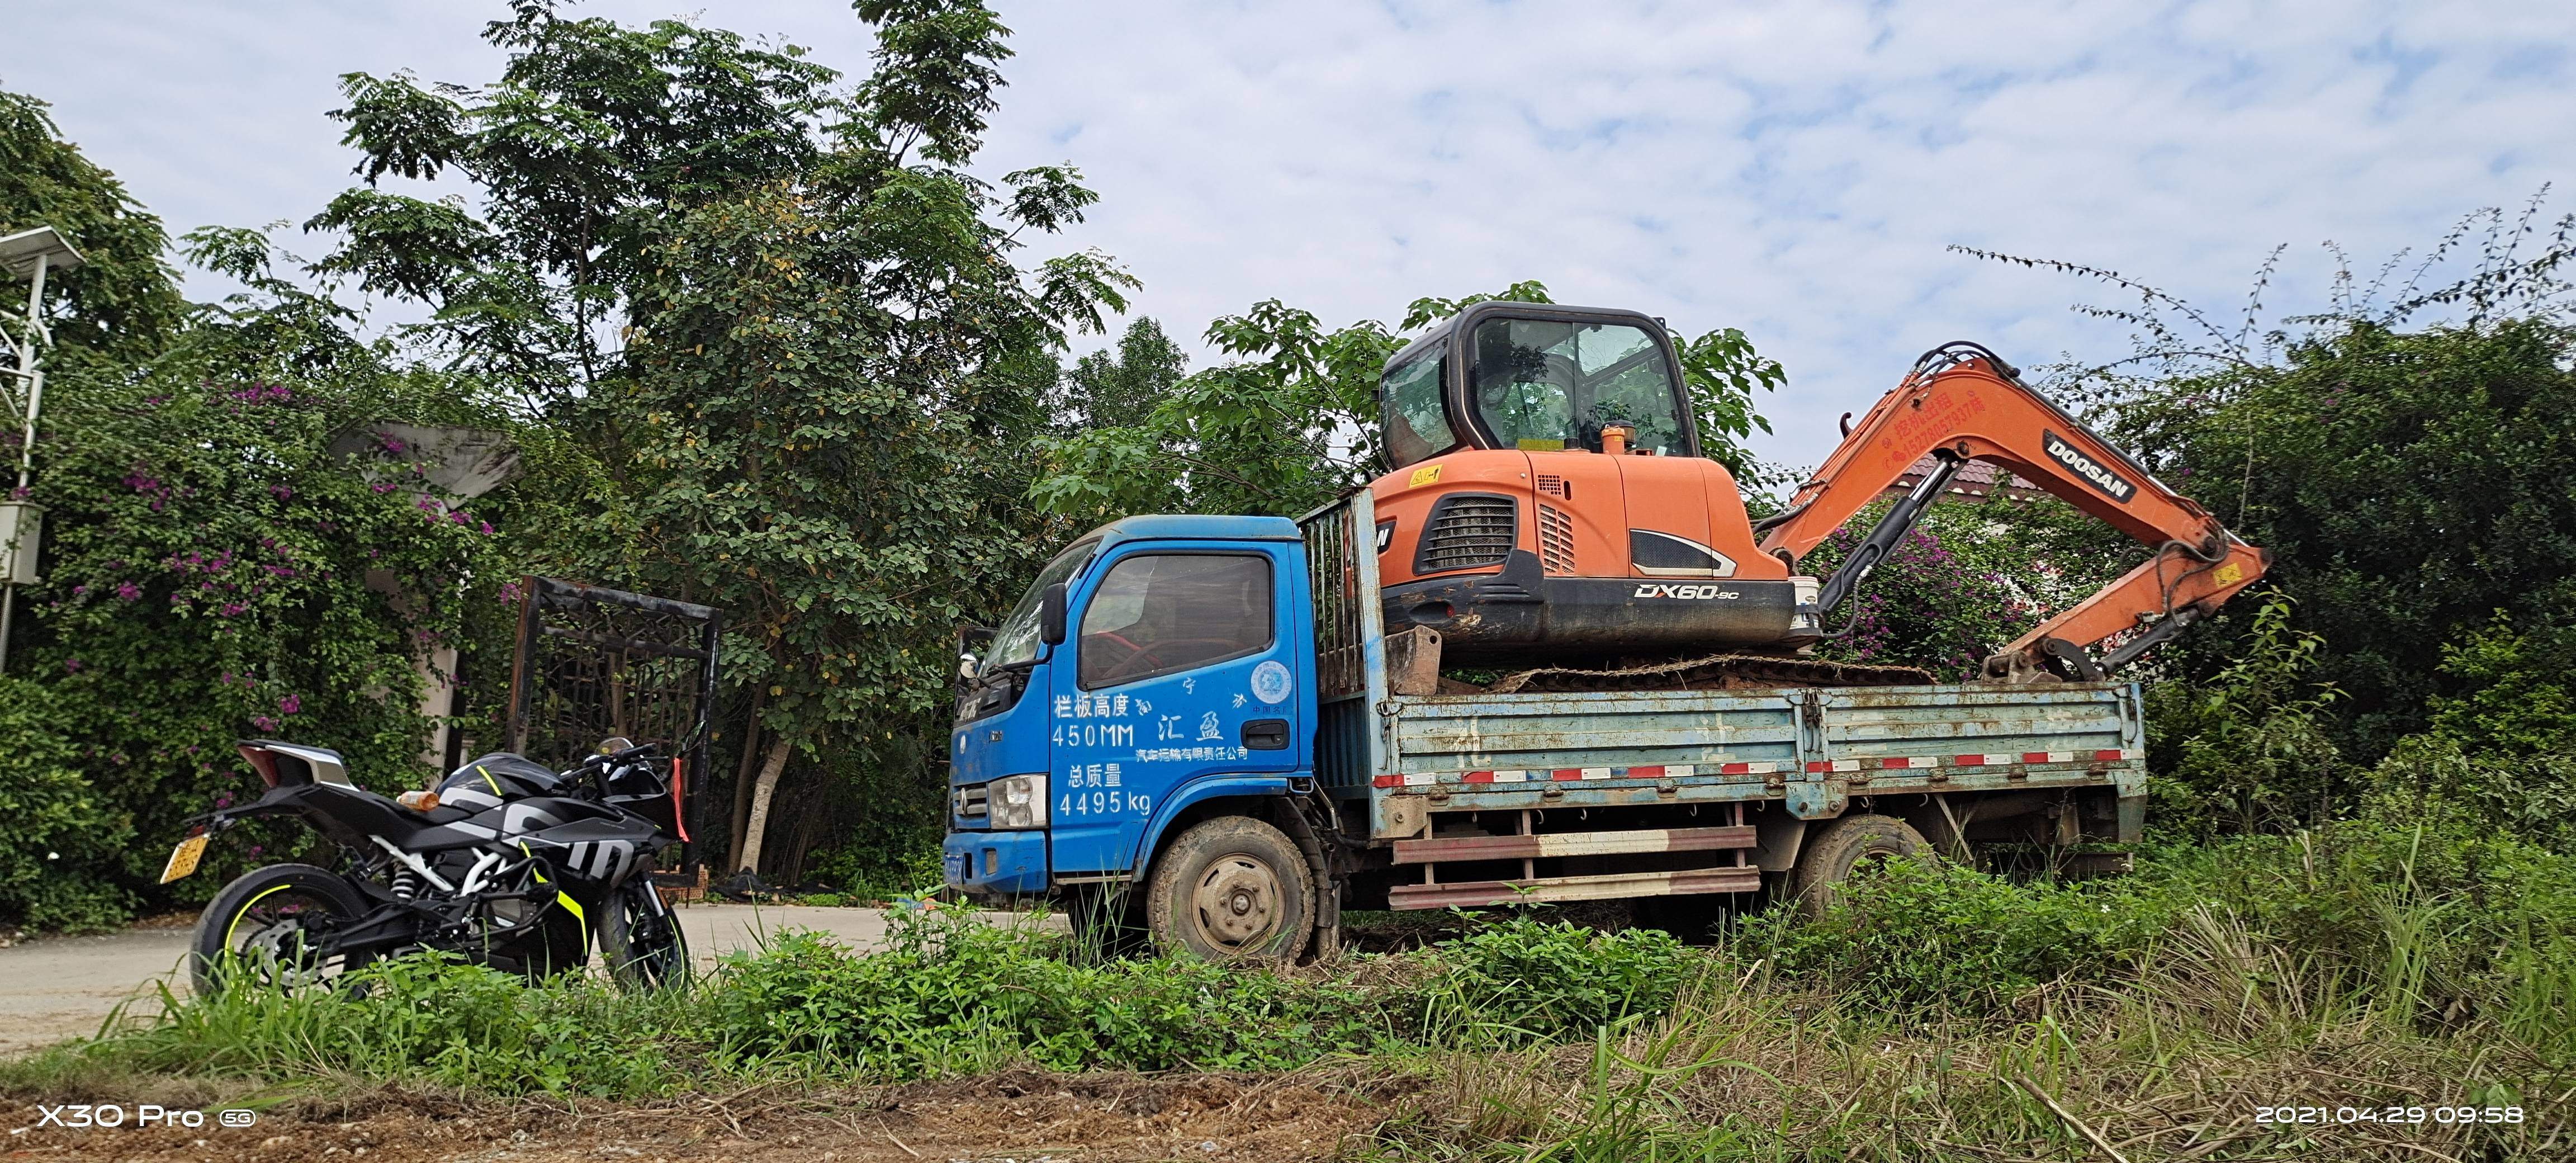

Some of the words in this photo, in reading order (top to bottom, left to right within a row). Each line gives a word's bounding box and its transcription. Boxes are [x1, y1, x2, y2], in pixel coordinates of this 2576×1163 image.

[2047, 441, 2129, 498] DOOSAN
[1054, 694, 1129, 719] 栏板高度
[1158, 711, 1224, 741] 汇盈
[1135, 746, 1248, 763] 汽车运输有限责任公司
[1068, 763, 1122, 788] 总质量
